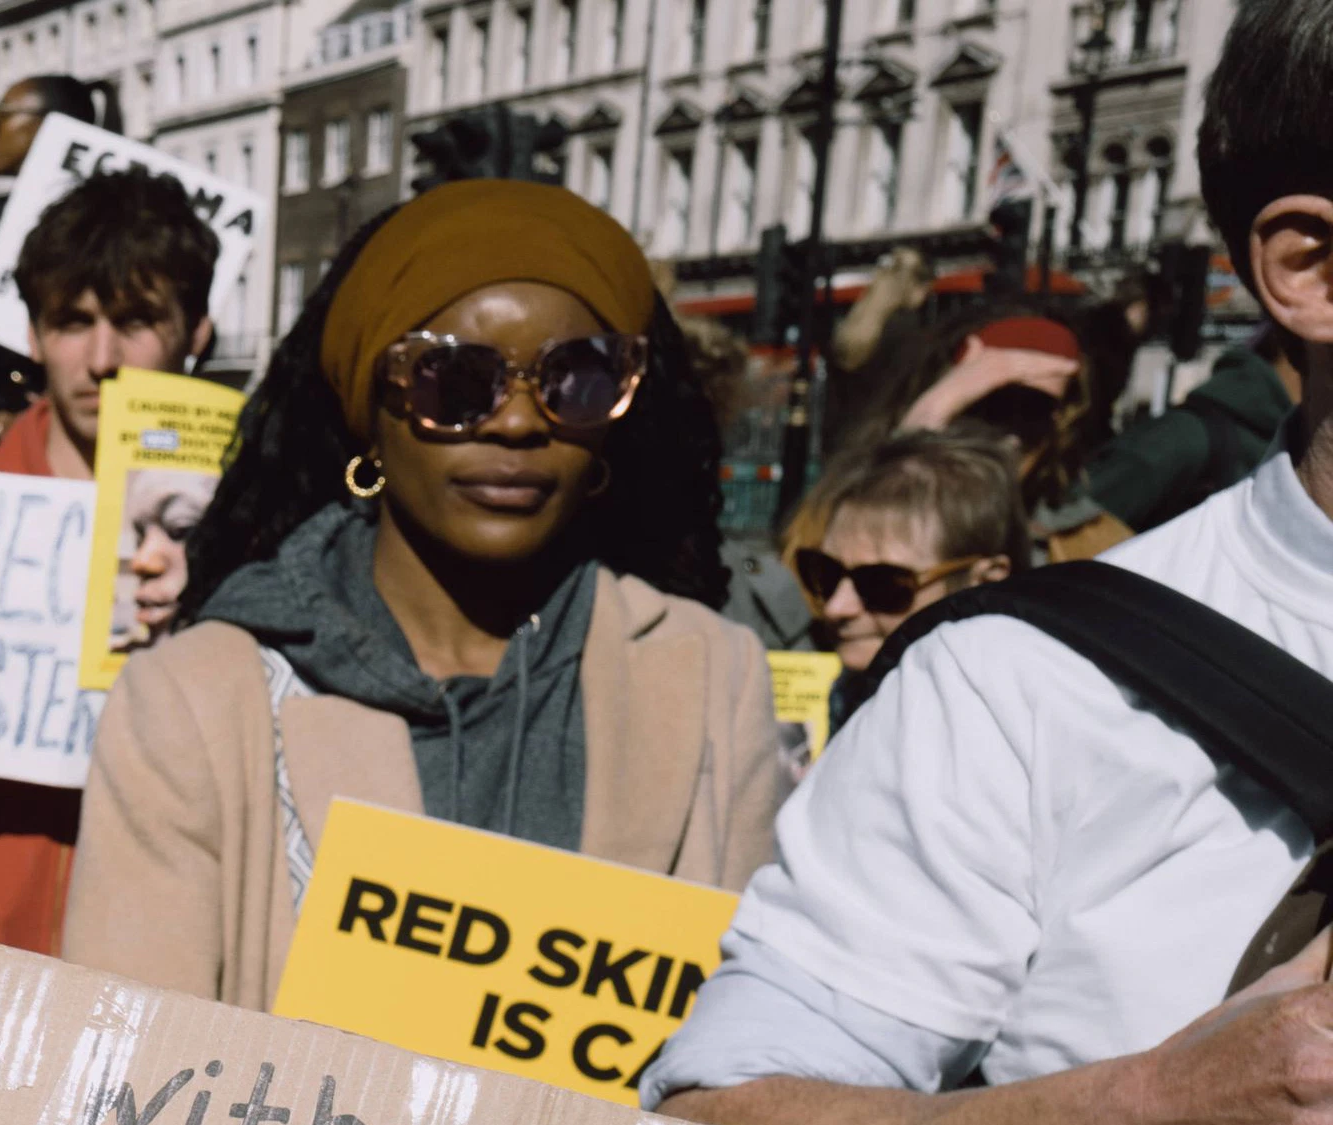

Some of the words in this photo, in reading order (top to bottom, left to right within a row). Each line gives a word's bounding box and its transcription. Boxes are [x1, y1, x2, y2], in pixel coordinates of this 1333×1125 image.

[62, 142, 252, 236] ECMA
[337, 876, 511, 967] RED
[471, 993, 552, 1061] IS
